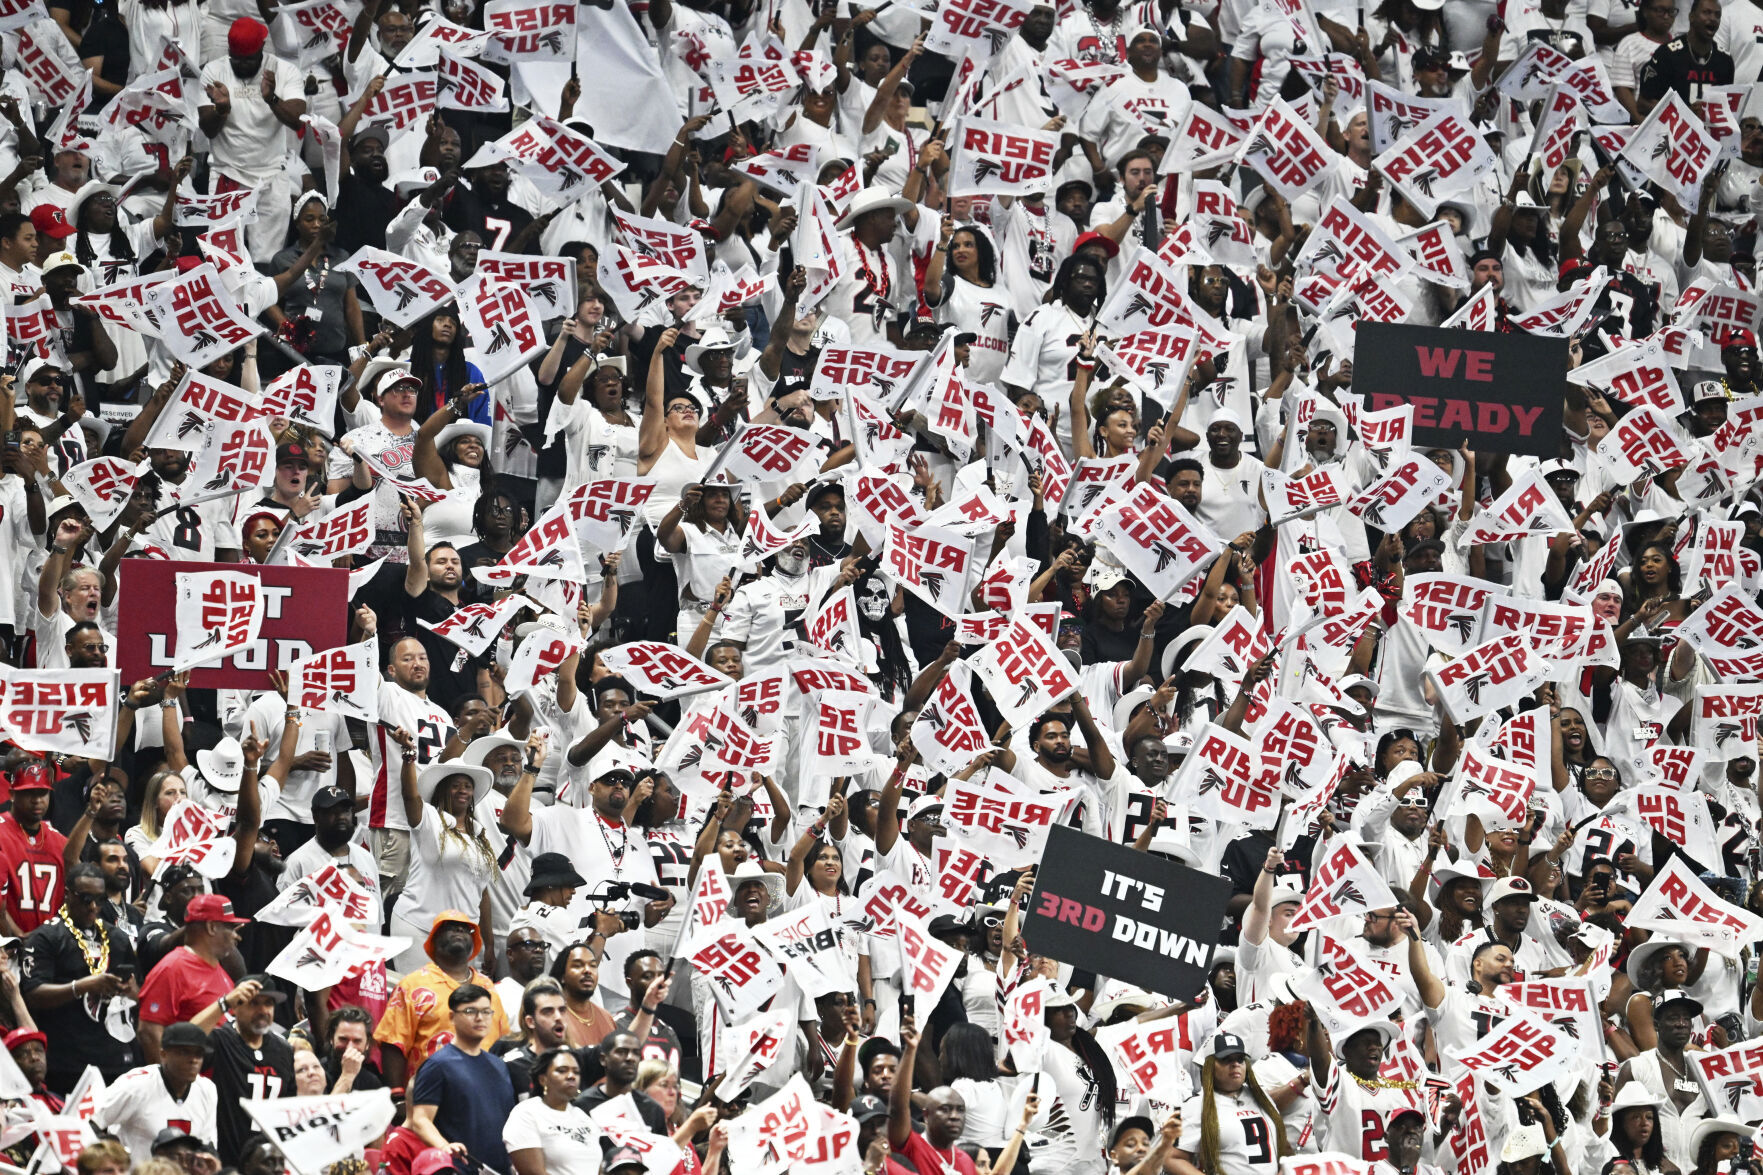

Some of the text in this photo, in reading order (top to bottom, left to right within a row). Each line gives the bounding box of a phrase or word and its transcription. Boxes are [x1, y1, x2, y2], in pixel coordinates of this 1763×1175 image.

[16, 27, 77, 102] RISE
[1136, 97, 1170, 109] ATL
[1374, 91, 1433, 121] RIS
[963, 128, 1053, 165] RISE
[1264, 104, 1327, 177] RISE
[1383, 116, 1465, 183] RISE
[1658, 101, 1711, 170] RISE
[1000, 160, 1046, 183] UP
[1266, 152, 1306, 187] UP
[1434, 135, 1476, 178] UP
[1665, 146, 1699, 186] UP
[485, 216, 512, 253] 7
[1321, 205, 1401, 281] RISE
[969, 335, 1007, 352] ALCONS
[1415, 345, 1495, 382] WE
[181, 380, 265, 422] RISE
[293, 368, 317, 412] UP
[742, 425, 810, 463] RISE
[742, 440, 791, 473] UP
[1381, 461, 1421, 506] UP
[174, 505, 201, 552] 8
[321, 532, 369, 556] UP
[1495, 603, 1586, 637] RISE
[147, 632, 316, 671] LUD
[331, 650, 355, 693] UP
[1488, 648, 1527, 685] UP
[301, 653, 327, 710] RISE
[792, 670, 868, 693] RISE
[937, 676, 986, 754] RISE
[718, 745, 769, 767] UP
[818, 731, 860, 755] UP
[934, 720, 974, 758] UP
[1288, 720, 1318, 767] UP
[1221, 776, 1272, 812] UP
[1487, 790, 1526, 823] UP
[17, 863, 58, 912] 17
[316, 864, 369, 906] ISE
[1101, 870, 1165, 913] IT'S
[1659, 868, 1748, 936] RISE
[1036, 892, 1208, 968] 3RD DOWN
[722, 954, 762, 988] UP
[1323, 975, 1369, 1018] UP
[1460, 1020, 1541, 1071] RISE
[1519, 1035, 1556, 1071] UP
[1699, 1044, 1763, 1080] RIS
[1240, 1117, 1273, 1163] 9
[1457, 1072, 1489, 1169] RISE
